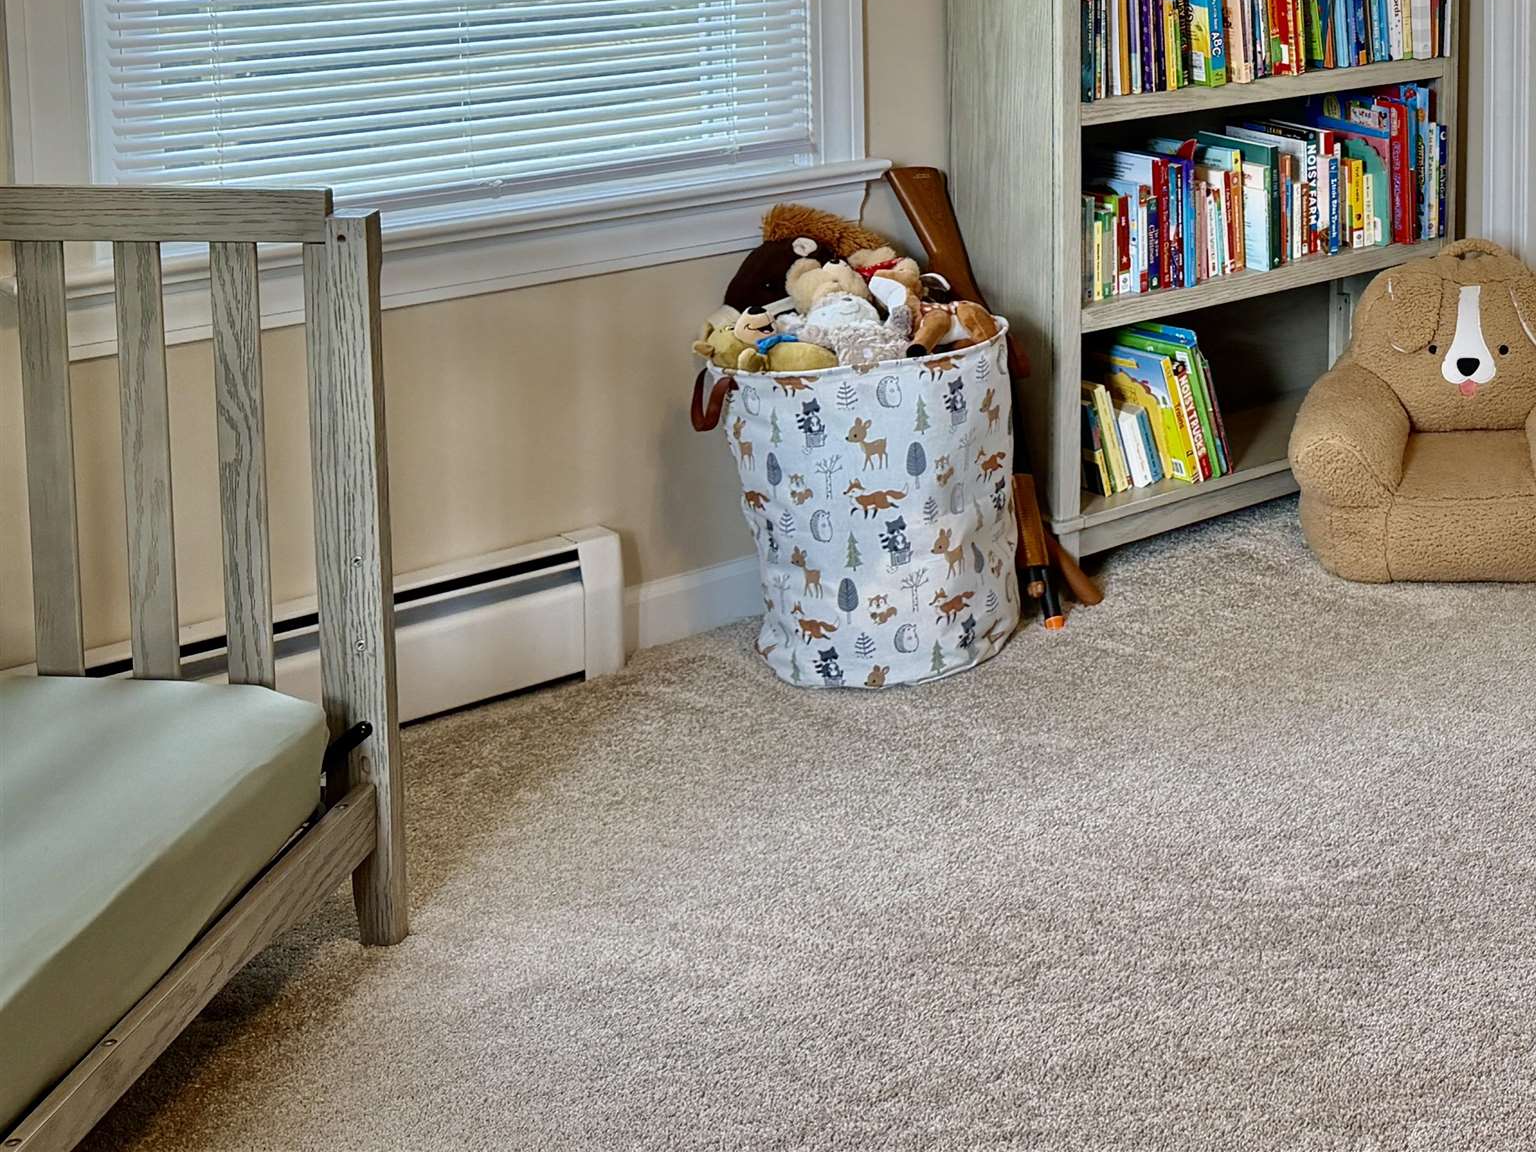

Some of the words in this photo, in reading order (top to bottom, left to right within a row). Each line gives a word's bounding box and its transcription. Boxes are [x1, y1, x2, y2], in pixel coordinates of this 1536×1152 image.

[1211, 31, 1222, 57] ABC
[1307, 144, 1317, 187] NOISY
[1308, 190, 1318, 224] FARM
[1175, 403, 1184, 430] Trains
[1179, 373, 1194, 411] NOISY
[1187, 410, 1206, 456] TRUCKS
